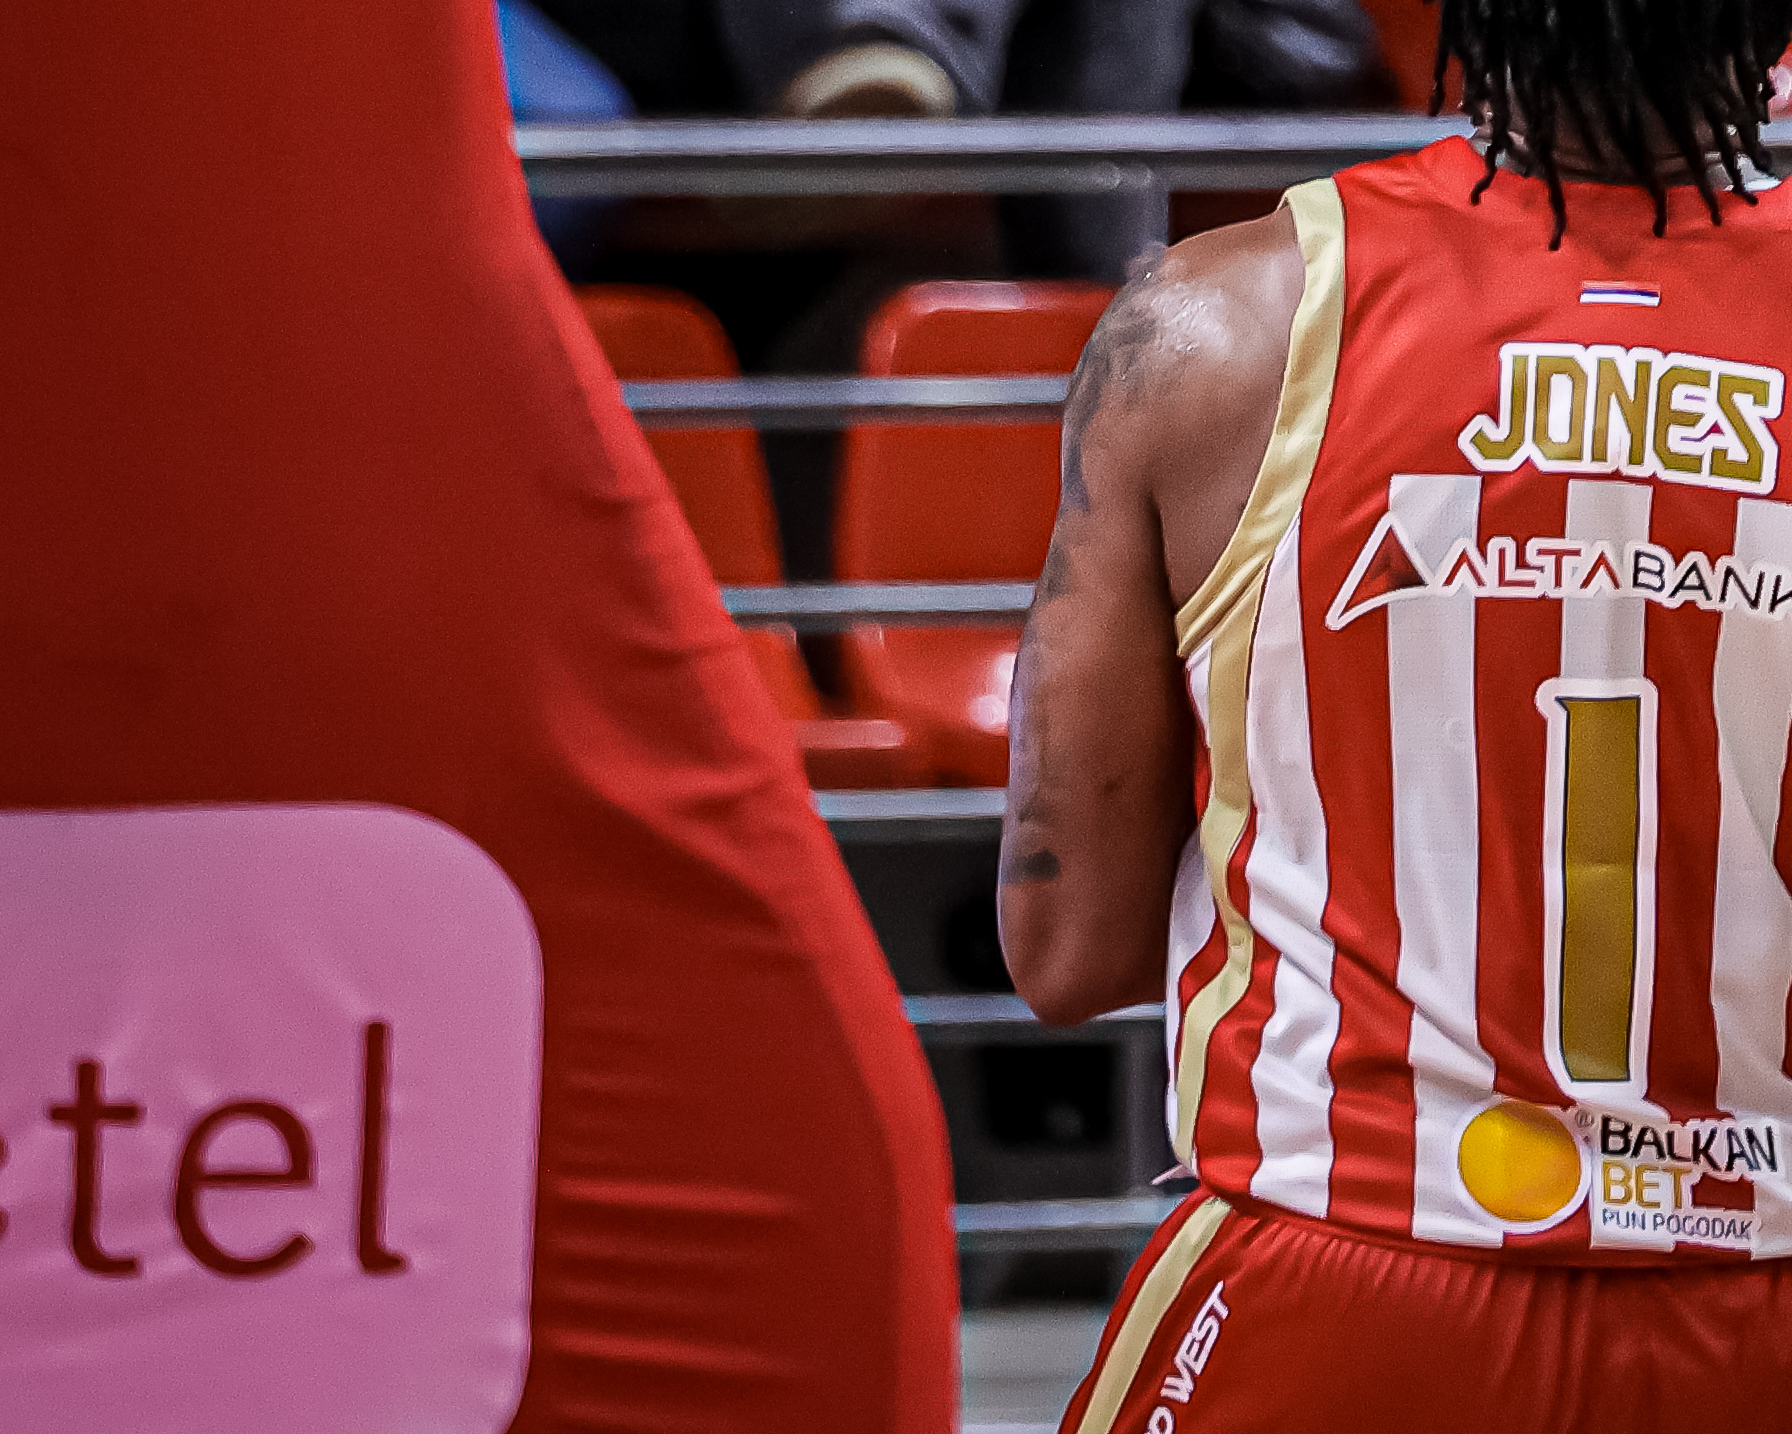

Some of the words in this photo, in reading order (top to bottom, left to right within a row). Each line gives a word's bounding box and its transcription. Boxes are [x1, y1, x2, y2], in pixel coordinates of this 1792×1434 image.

[1459, 343, 1783, 494] JONES
[1538, 680, 1656, 1098] 1
[0, 1020, 408, 1280] tel
[1600, 1113, 1778, 1172] BALKAN
[1602, 1159, 1692, 1210] BET
[1602, 1207, 1647, 1231] PUN
[1652, 1211, 1753, 1240] POGODAK
[1159, 1279, 1230, 1404] WEST
